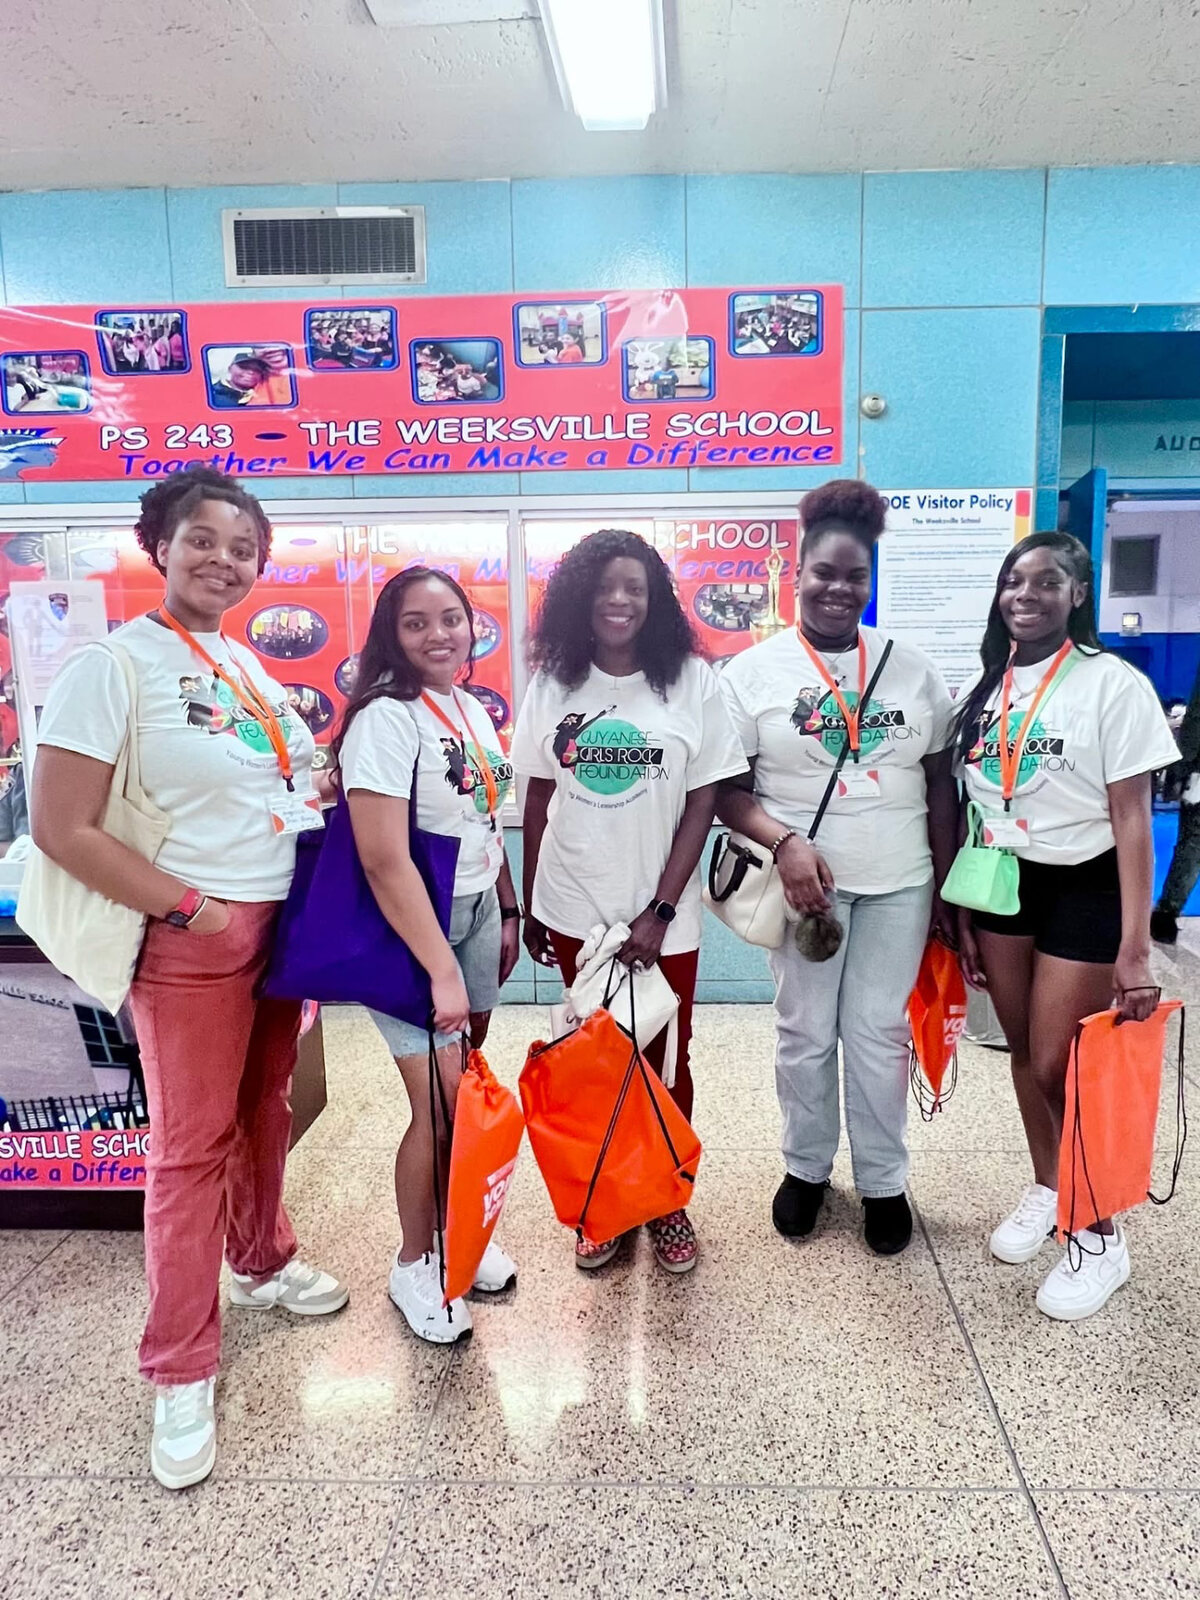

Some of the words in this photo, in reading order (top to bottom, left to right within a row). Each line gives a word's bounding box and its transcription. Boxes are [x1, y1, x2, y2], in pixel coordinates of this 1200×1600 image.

[100, 425, 149, 450] PS
[165, 424, 234, 449] 243
[299, 420, 381, 446] THE
[396, 413, 651, 444] WEEKSVILLE
[666, 409, 833, 438] SCHOOL
[118, 451, 287, 475] Togther
[308, 449, 366, 472] We
[384, 448, 451, 470] Can
[467, 445, 568, 468] Make
[587, 450, 608, 466] a
[627, 439, 833, 466] Difference
[917, 495, 965, 509] Visitor
[970, 494, 1013, 511] Policy
[581, 730, 660, 746] GUYANESE
[825, 725, 921, 745] FODATION
[1022, 738, 1057, 756] OCK
[580, 748, 613, 763] GIRLS
[618, 748, 658, 764] ROCK
[984, 756, 1076, 772] FODATION
[580, 764, 669, 780] FOUNDATION
[49, 1168, 61, 1181] a
